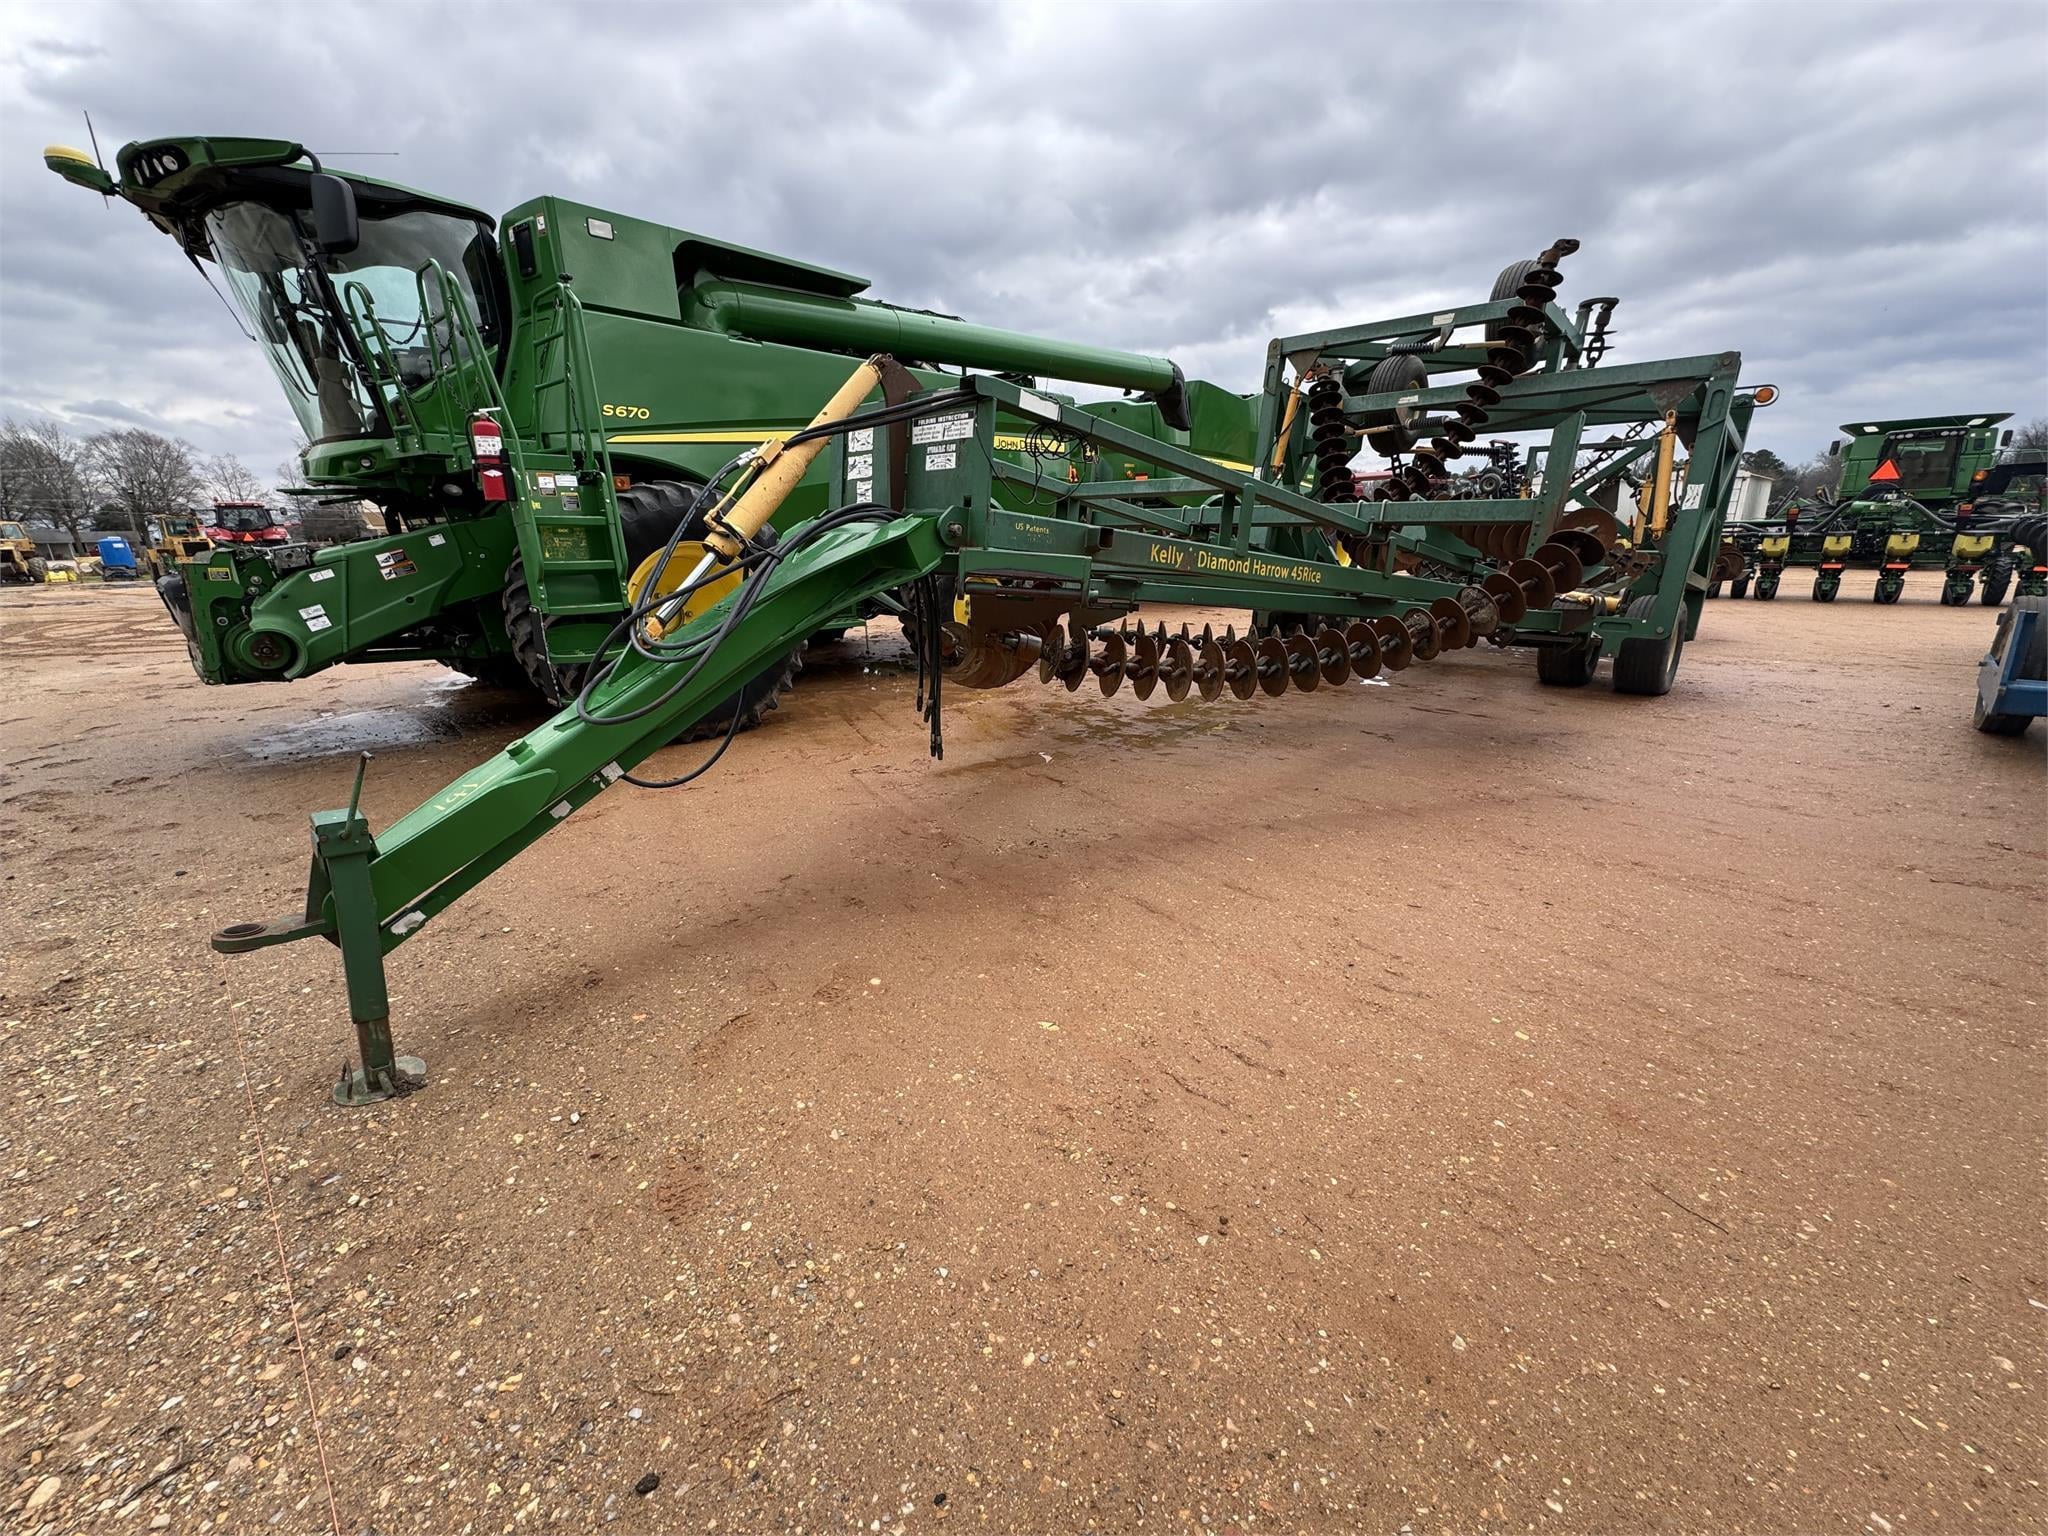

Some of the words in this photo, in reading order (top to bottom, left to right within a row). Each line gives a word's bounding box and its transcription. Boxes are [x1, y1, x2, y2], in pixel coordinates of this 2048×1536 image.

[602, 404, 650, 420] S670
[996, 438, 1019, 449] JOHN
[1015, 522, 1024, 531] US
[1150, 543, 1184, 568] Kelly
[1197, 550, 1251, 574] Diamond
[1252, 559, 1290, 579] Harrow
[1291, 566, 1322, 584] 45Rice
